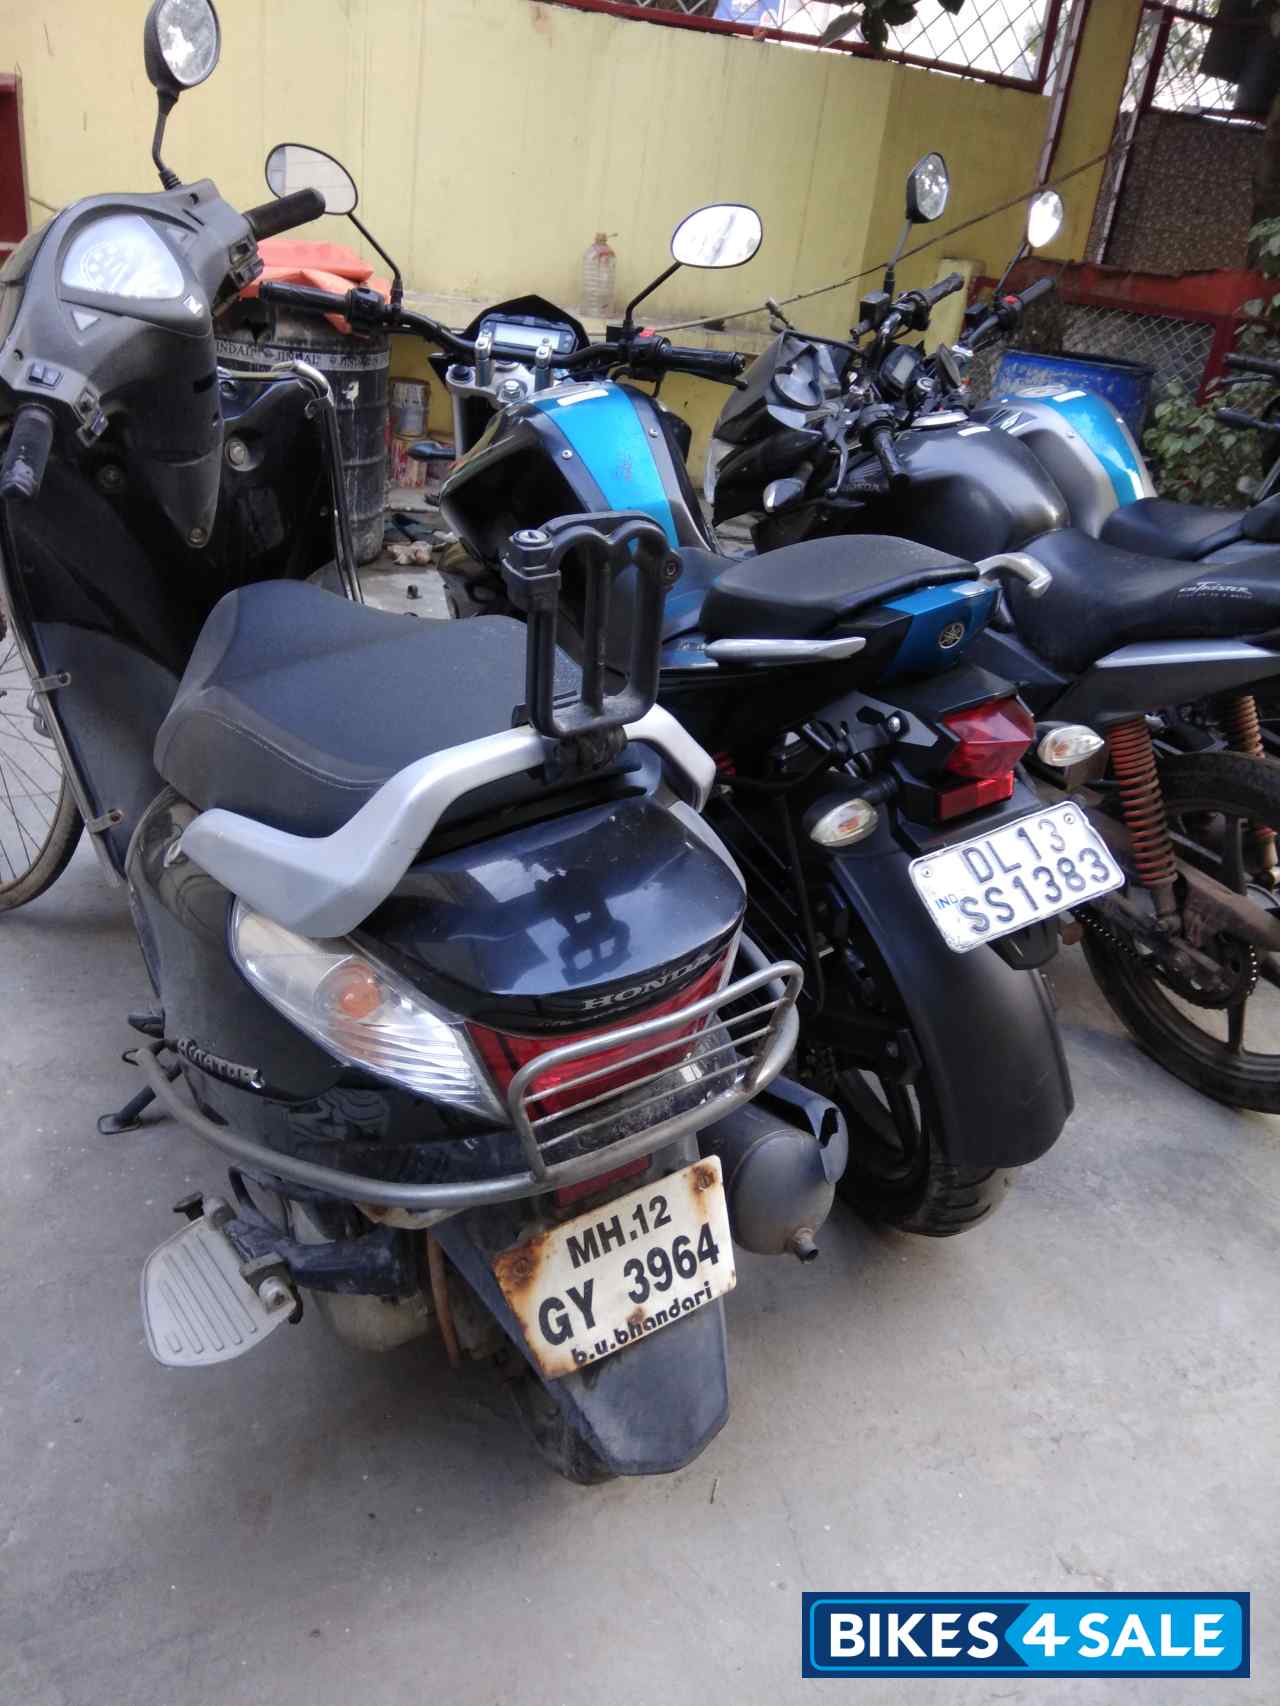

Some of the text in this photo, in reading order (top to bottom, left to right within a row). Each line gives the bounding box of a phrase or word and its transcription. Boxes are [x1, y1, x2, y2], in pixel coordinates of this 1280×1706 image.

[935, 893, 960, 910] IND
[959, 848, 1110, 933] SS1383
[581, 953, 712, 1011] HONDA
[566, 1195, 672, 1269] MH.12
[538, 1222, 720, 1346] GY 3964
